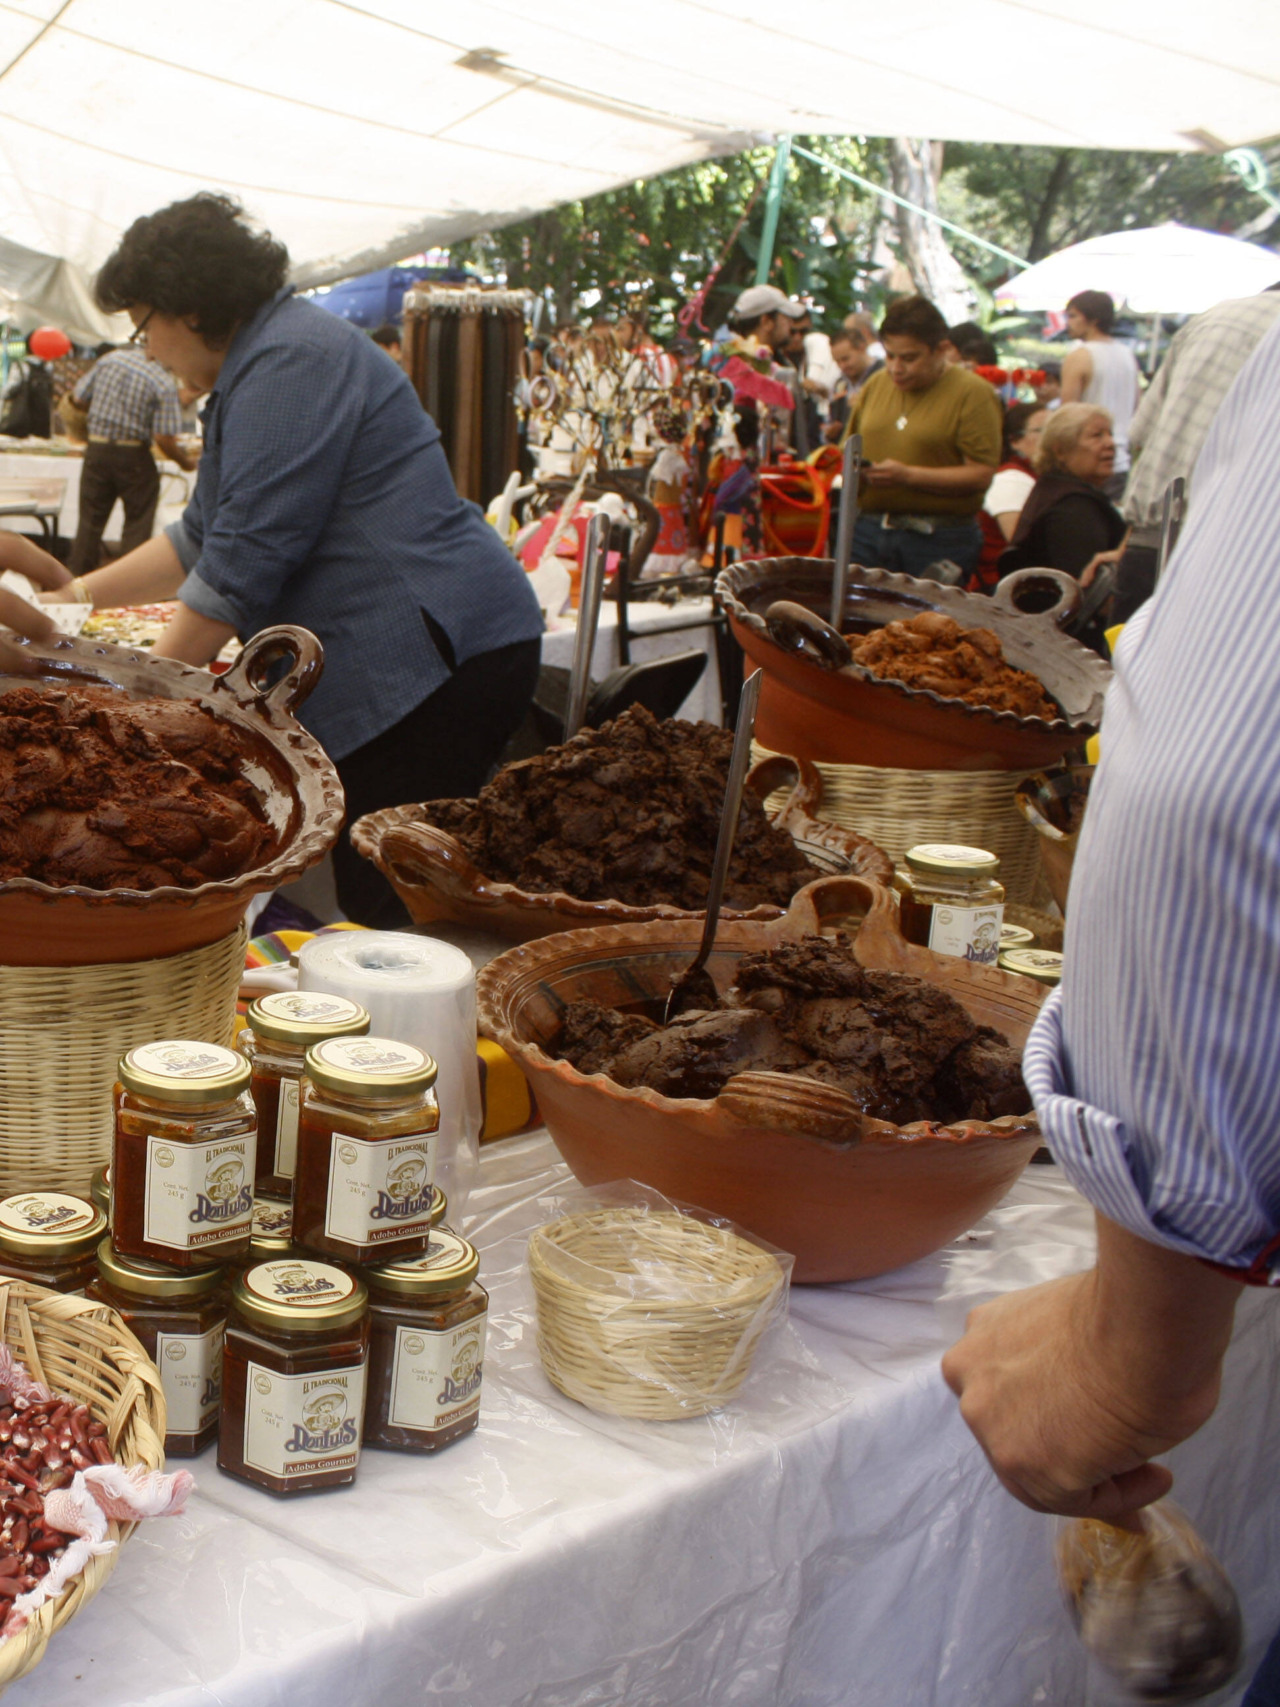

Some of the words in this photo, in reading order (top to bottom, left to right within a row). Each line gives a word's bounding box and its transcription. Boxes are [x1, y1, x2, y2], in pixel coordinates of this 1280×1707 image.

[191, 1233, 217, 1244] Adobo
[218, 1225, 250, 1238] Gourmet
[371, 1230, 397, 1240] Adobo
[287, 1464, 316, 1473] Adobo
[318, 1456, 354, 1468] Gourmet
